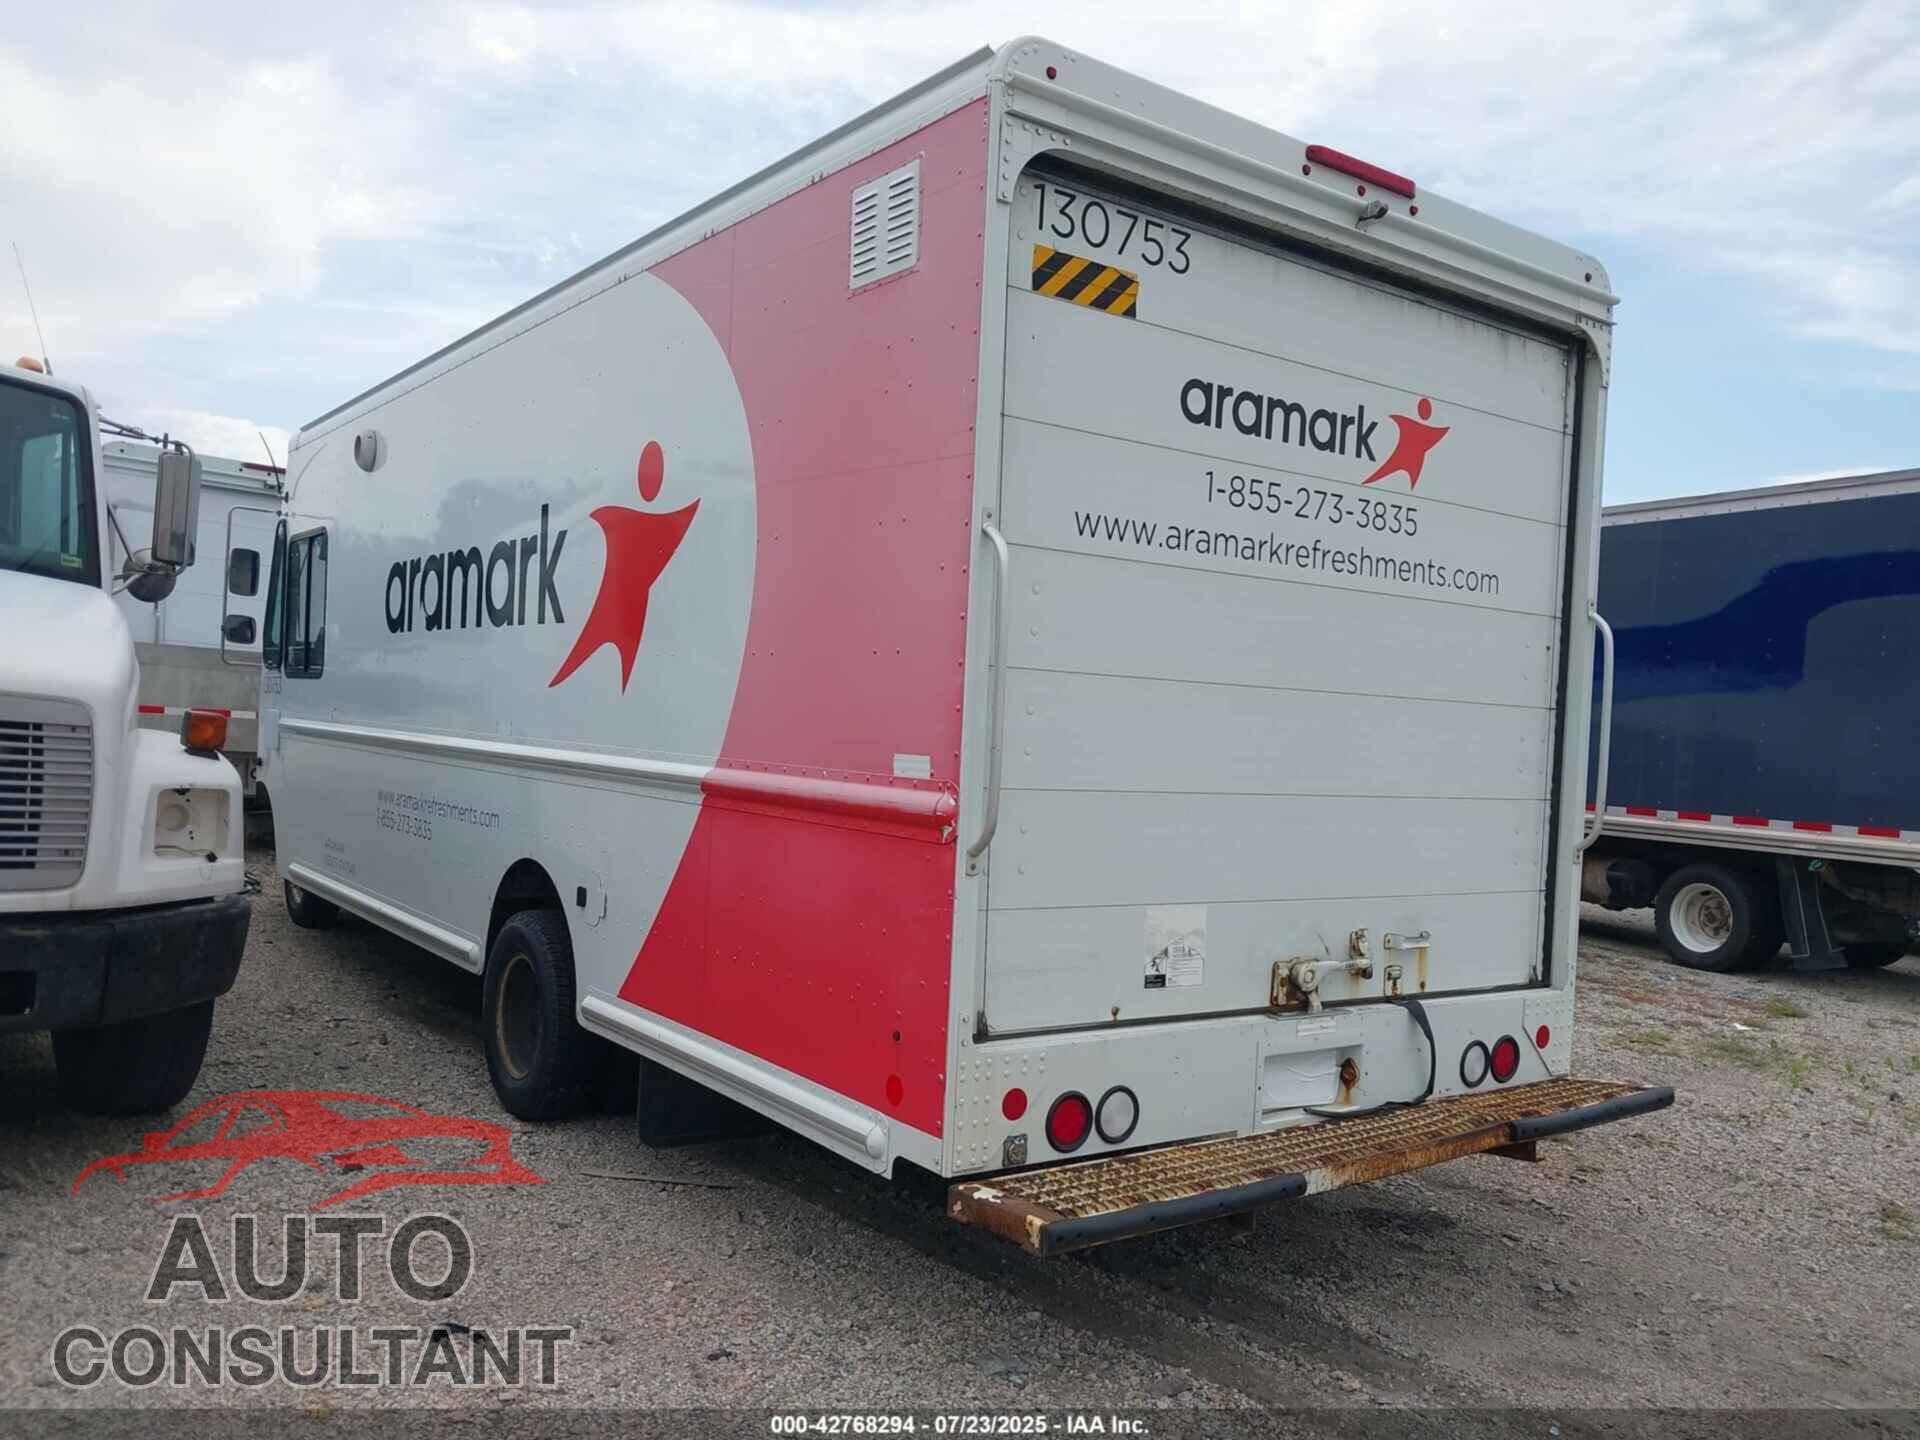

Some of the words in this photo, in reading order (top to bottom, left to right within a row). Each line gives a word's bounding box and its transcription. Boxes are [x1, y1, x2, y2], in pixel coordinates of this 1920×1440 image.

[1033, 183, 1192, 275] 130753
[1180, 377, 1379, 463] aramark
[1205, 471, 1419, 537] 1-855-273-3835
[385, 503, 568, 634] aramark
[1074, 510, 1500, 595] www.aramarkrefreshments.com
